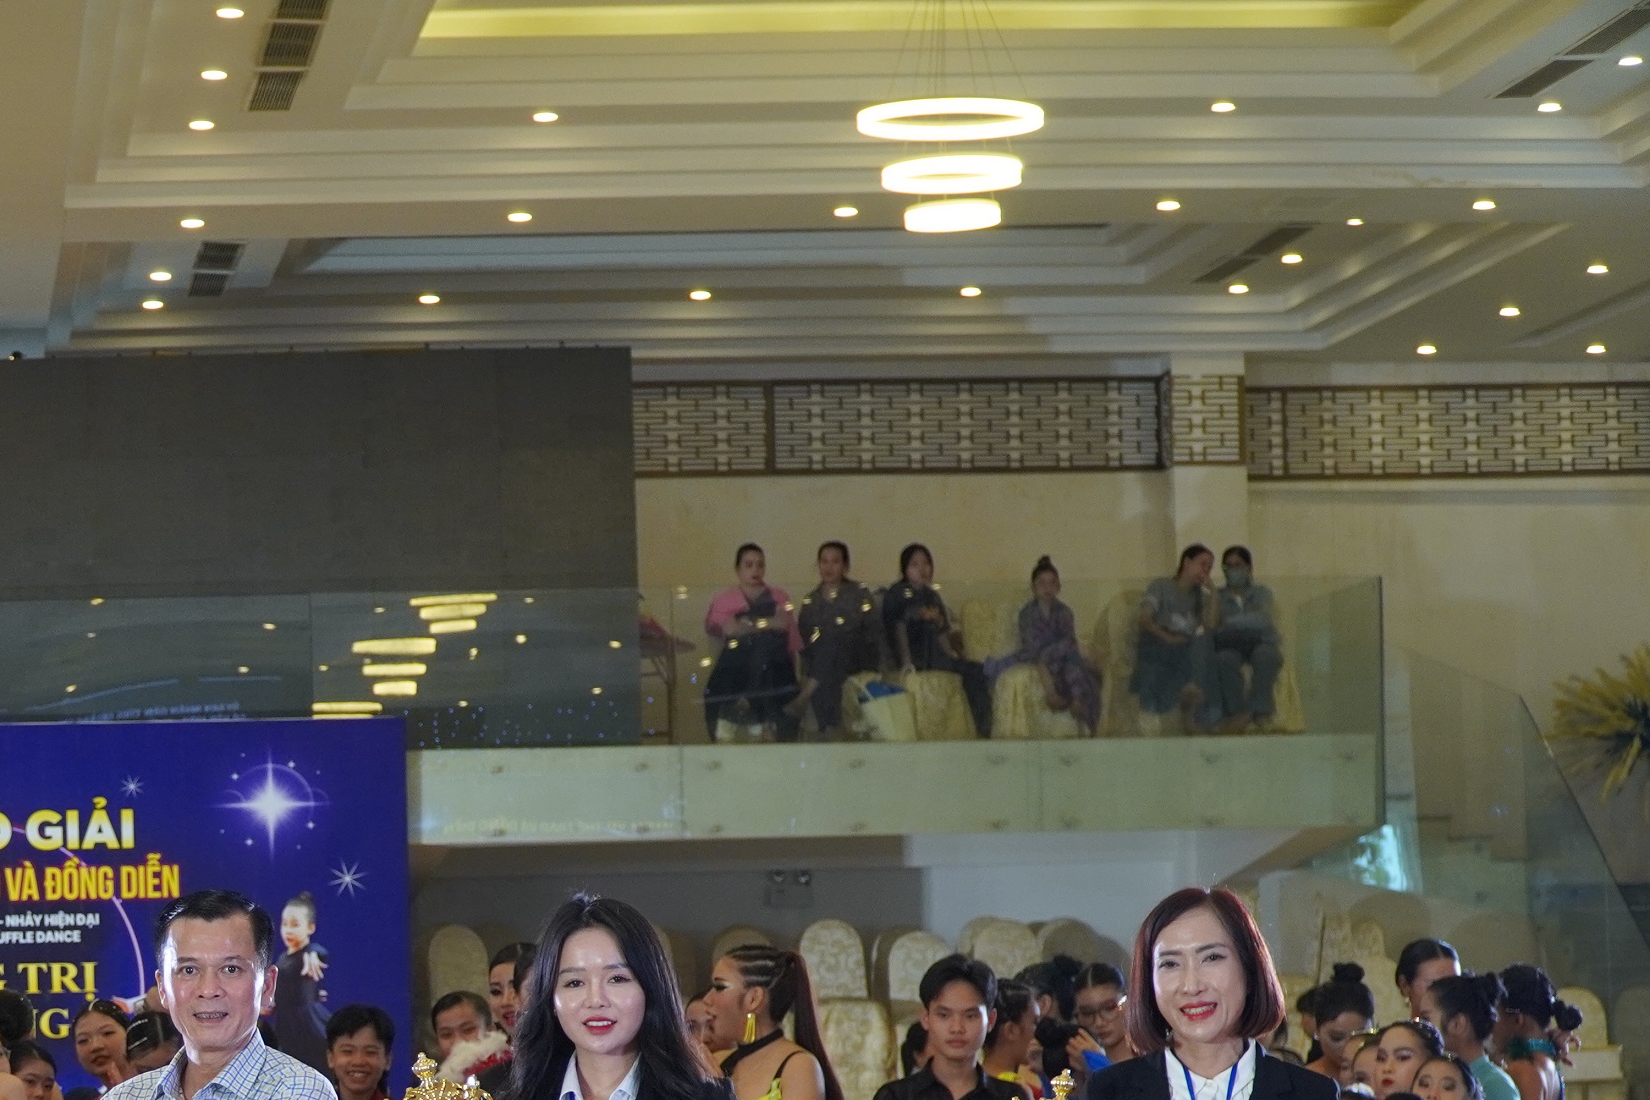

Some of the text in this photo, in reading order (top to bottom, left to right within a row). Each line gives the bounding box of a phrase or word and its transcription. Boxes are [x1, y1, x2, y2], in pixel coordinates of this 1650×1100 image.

[25, 796, 135, 851] GIẢI
[6, 853, 41, 901] VÀ
[45, 856, 114, 900] ĐỒNG
[121, 853, 180, 899] DIỄN
[6, 912, 44, 928] NHẢY
[46, 912, 76, 928] HIỆN
[76, 912, 100, 929] ĐẠI
[36, 930, 81, 943] DANCE
[18, 961, 98, 1001] TRỊ
